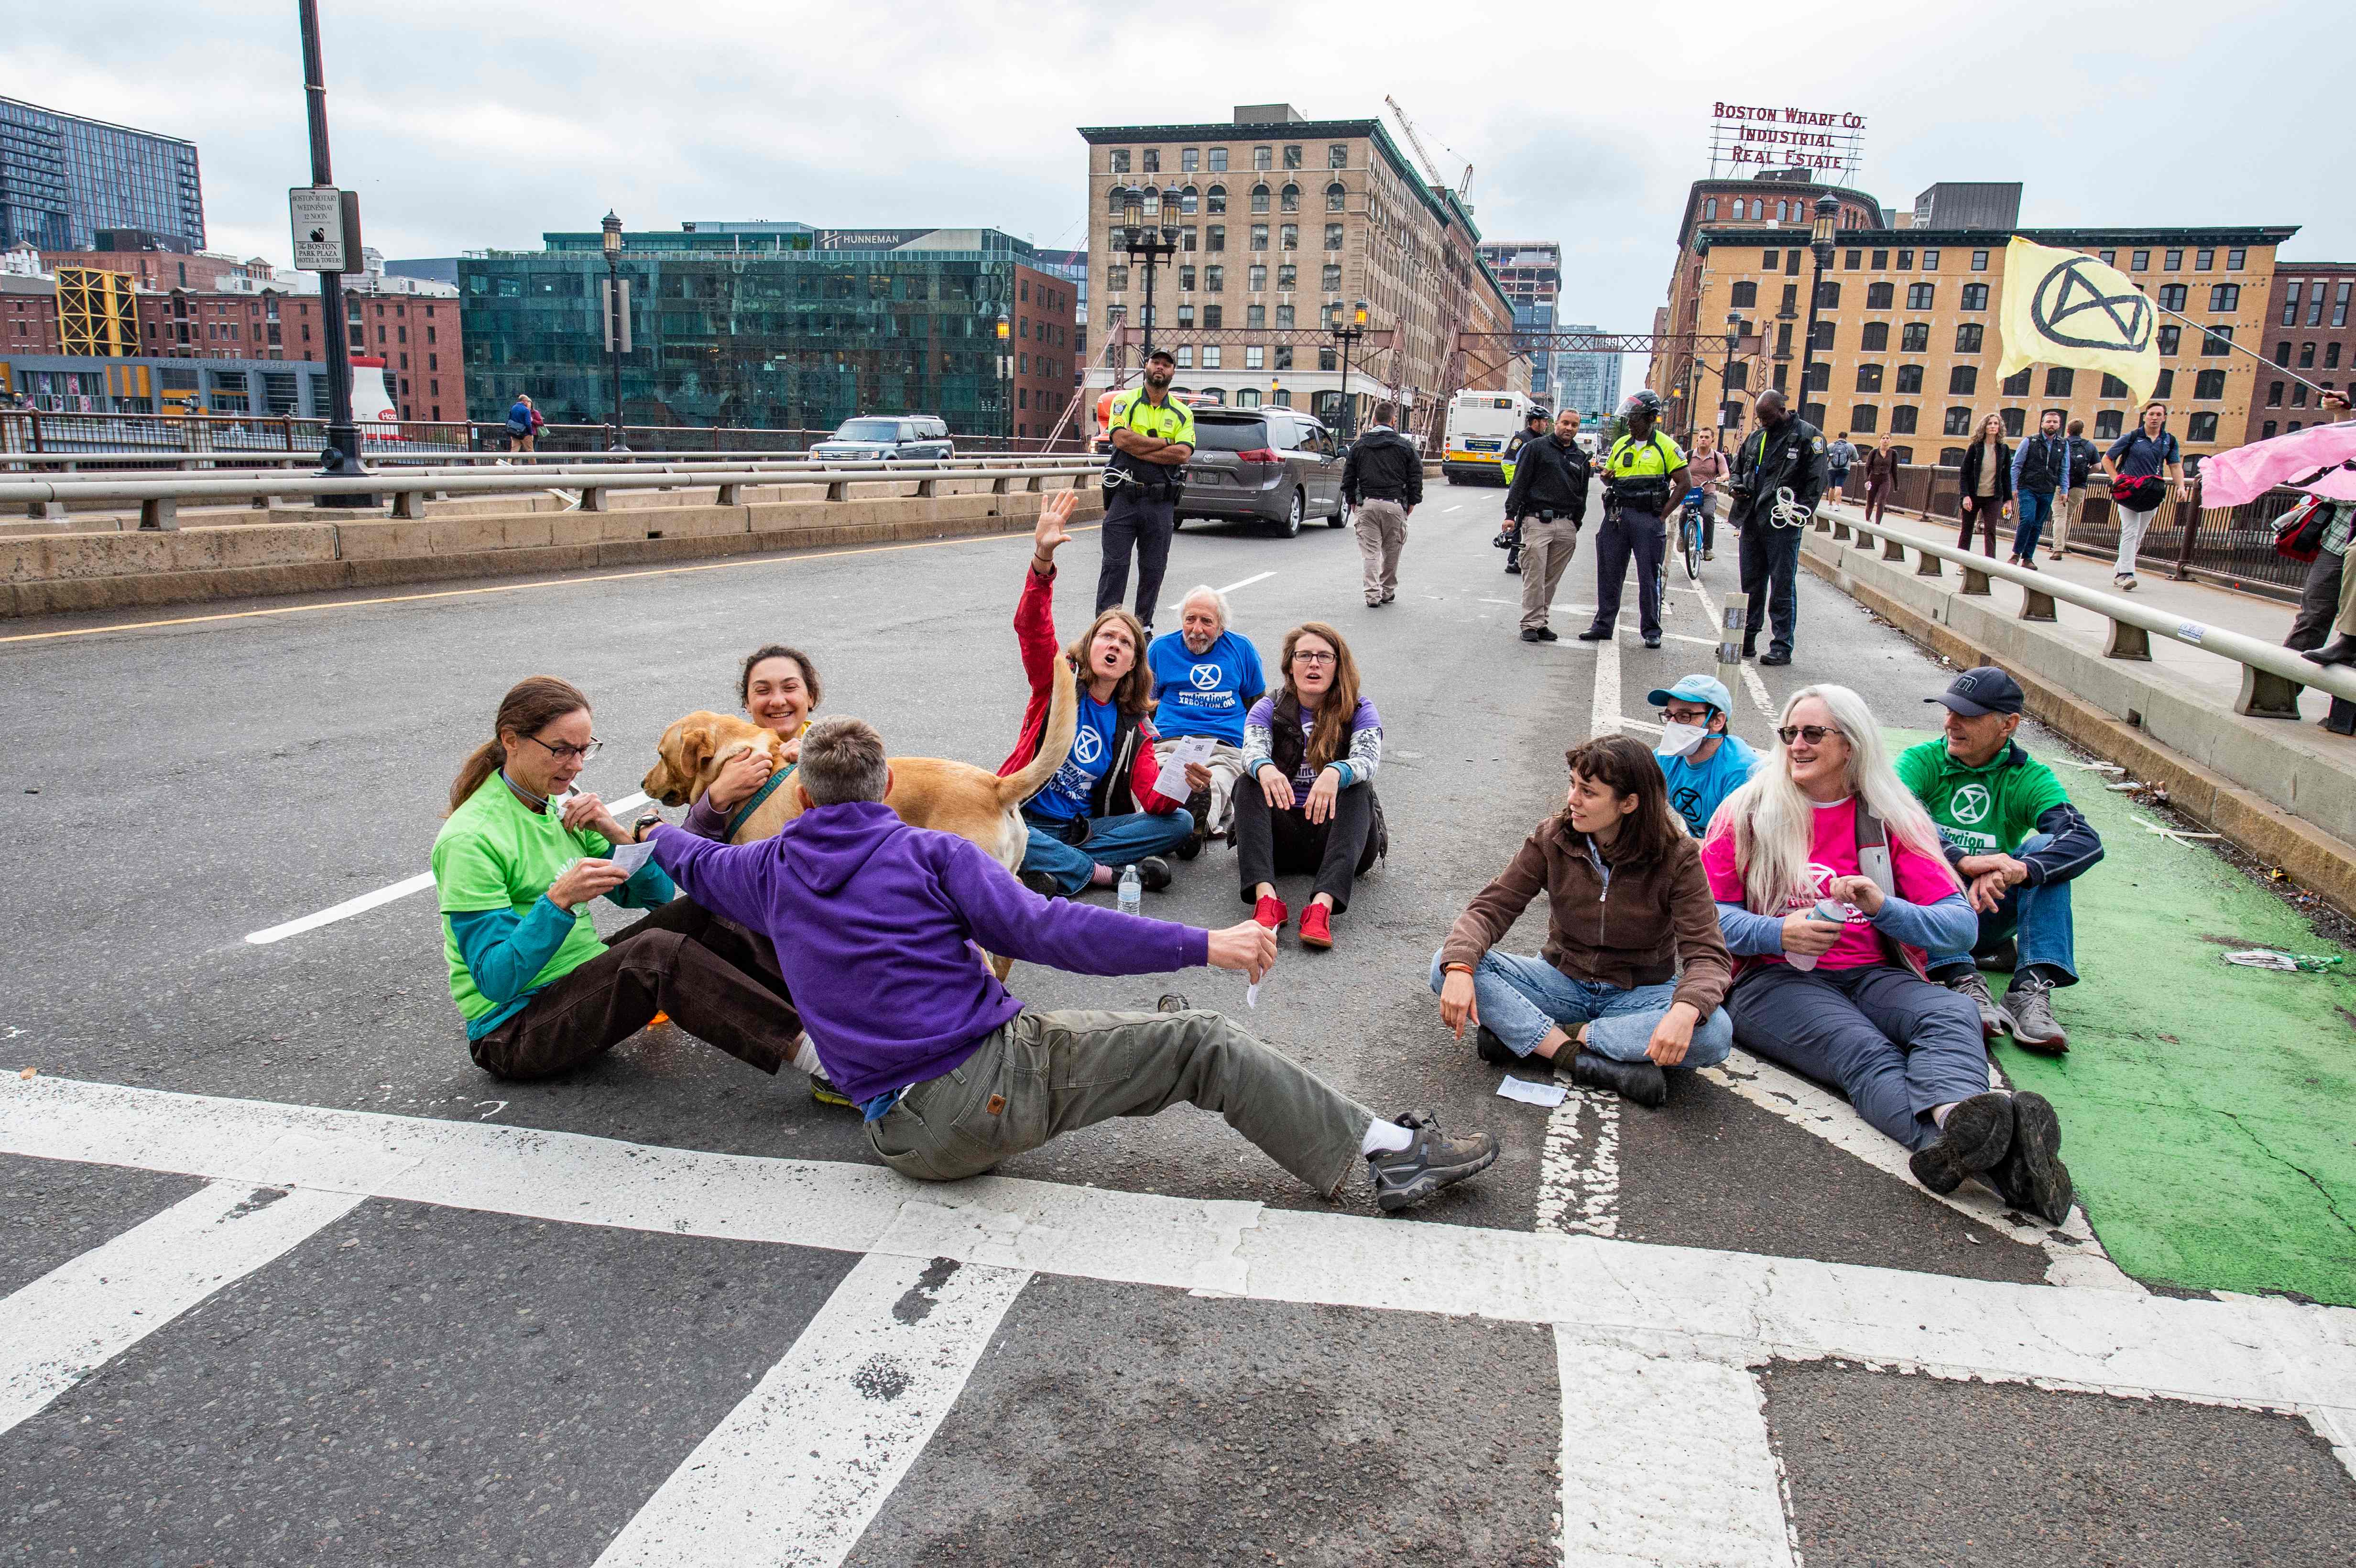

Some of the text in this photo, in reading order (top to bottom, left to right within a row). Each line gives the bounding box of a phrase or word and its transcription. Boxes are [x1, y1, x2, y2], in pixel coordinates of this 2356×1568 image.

[1714, 102, 1865, 128] BOSTON WHARF CO.
[1740, 125, 1835, 147] INDUSTRIAL
[1732, 146, 1844, 169] REAL ESTATE
[844, 235, 899, 243] HUNNEMAN
[154, 359, 296, 370] BOSTON CHILDREN'S MUSEUM
[1178, 697, 1236, 708] XRBOSTON.ORG
